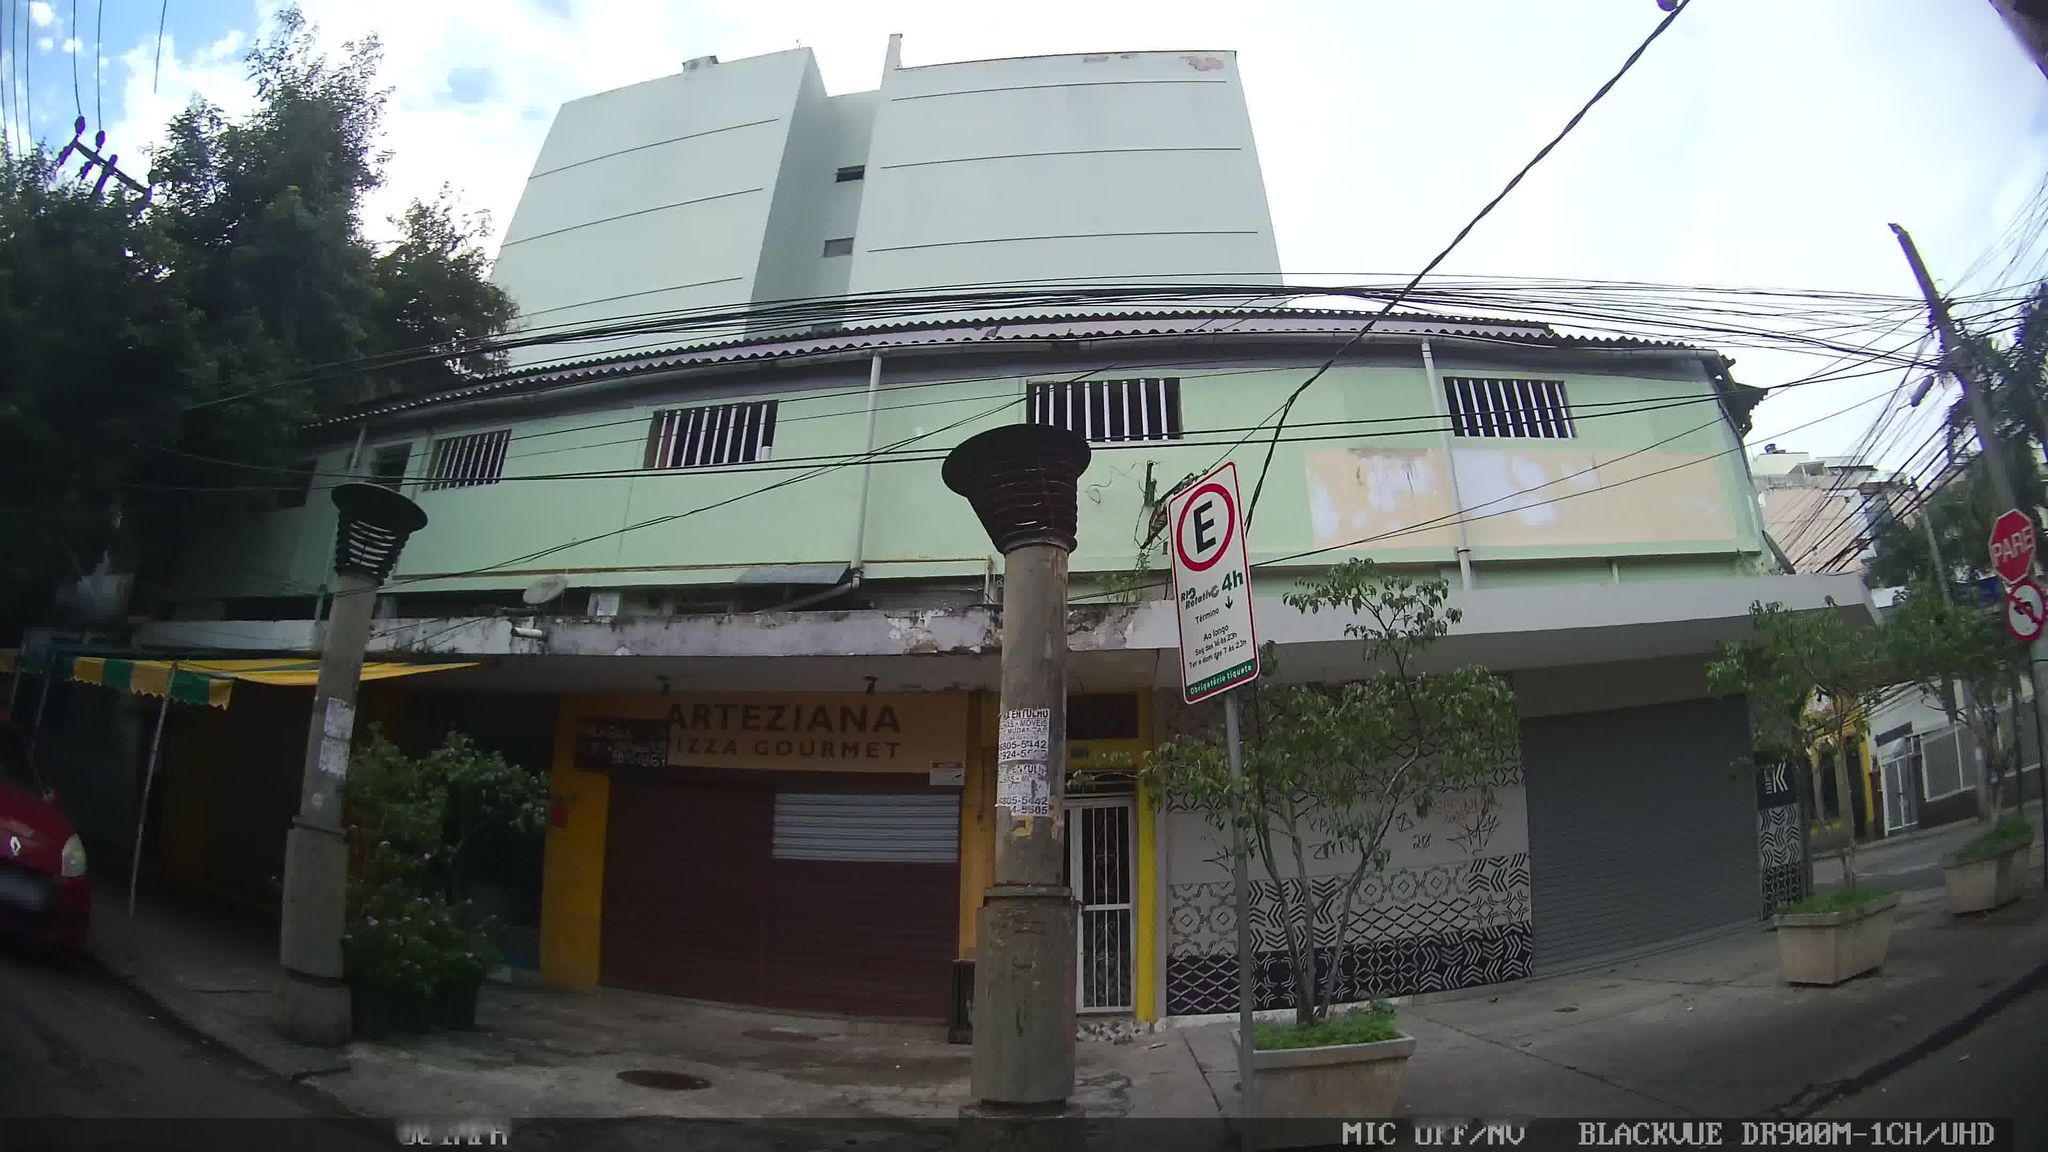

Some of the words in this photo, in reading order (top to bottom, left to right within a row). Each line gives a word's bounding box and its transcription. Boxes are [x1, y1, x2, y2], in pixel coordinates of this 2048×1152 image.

[1192, 499, 1217, 555] E
[1991, 525, 2034, 567] PARE
[1221, 570, 1244, 592] 4h
[1203, 631, 1212, 641] Ao
[1212, 624, 1229, 639] longo
[1227, 632, 1237, 643] 23h
[1189, 673, 1226, 695] Obrigatório
[1227, 664, 1252, 680] tiquete
[663, 704, 901, 733] ARTEZIANA
[669, 736, 737, 756] IZZA
[754, 739, 901, 759] GOURMET
